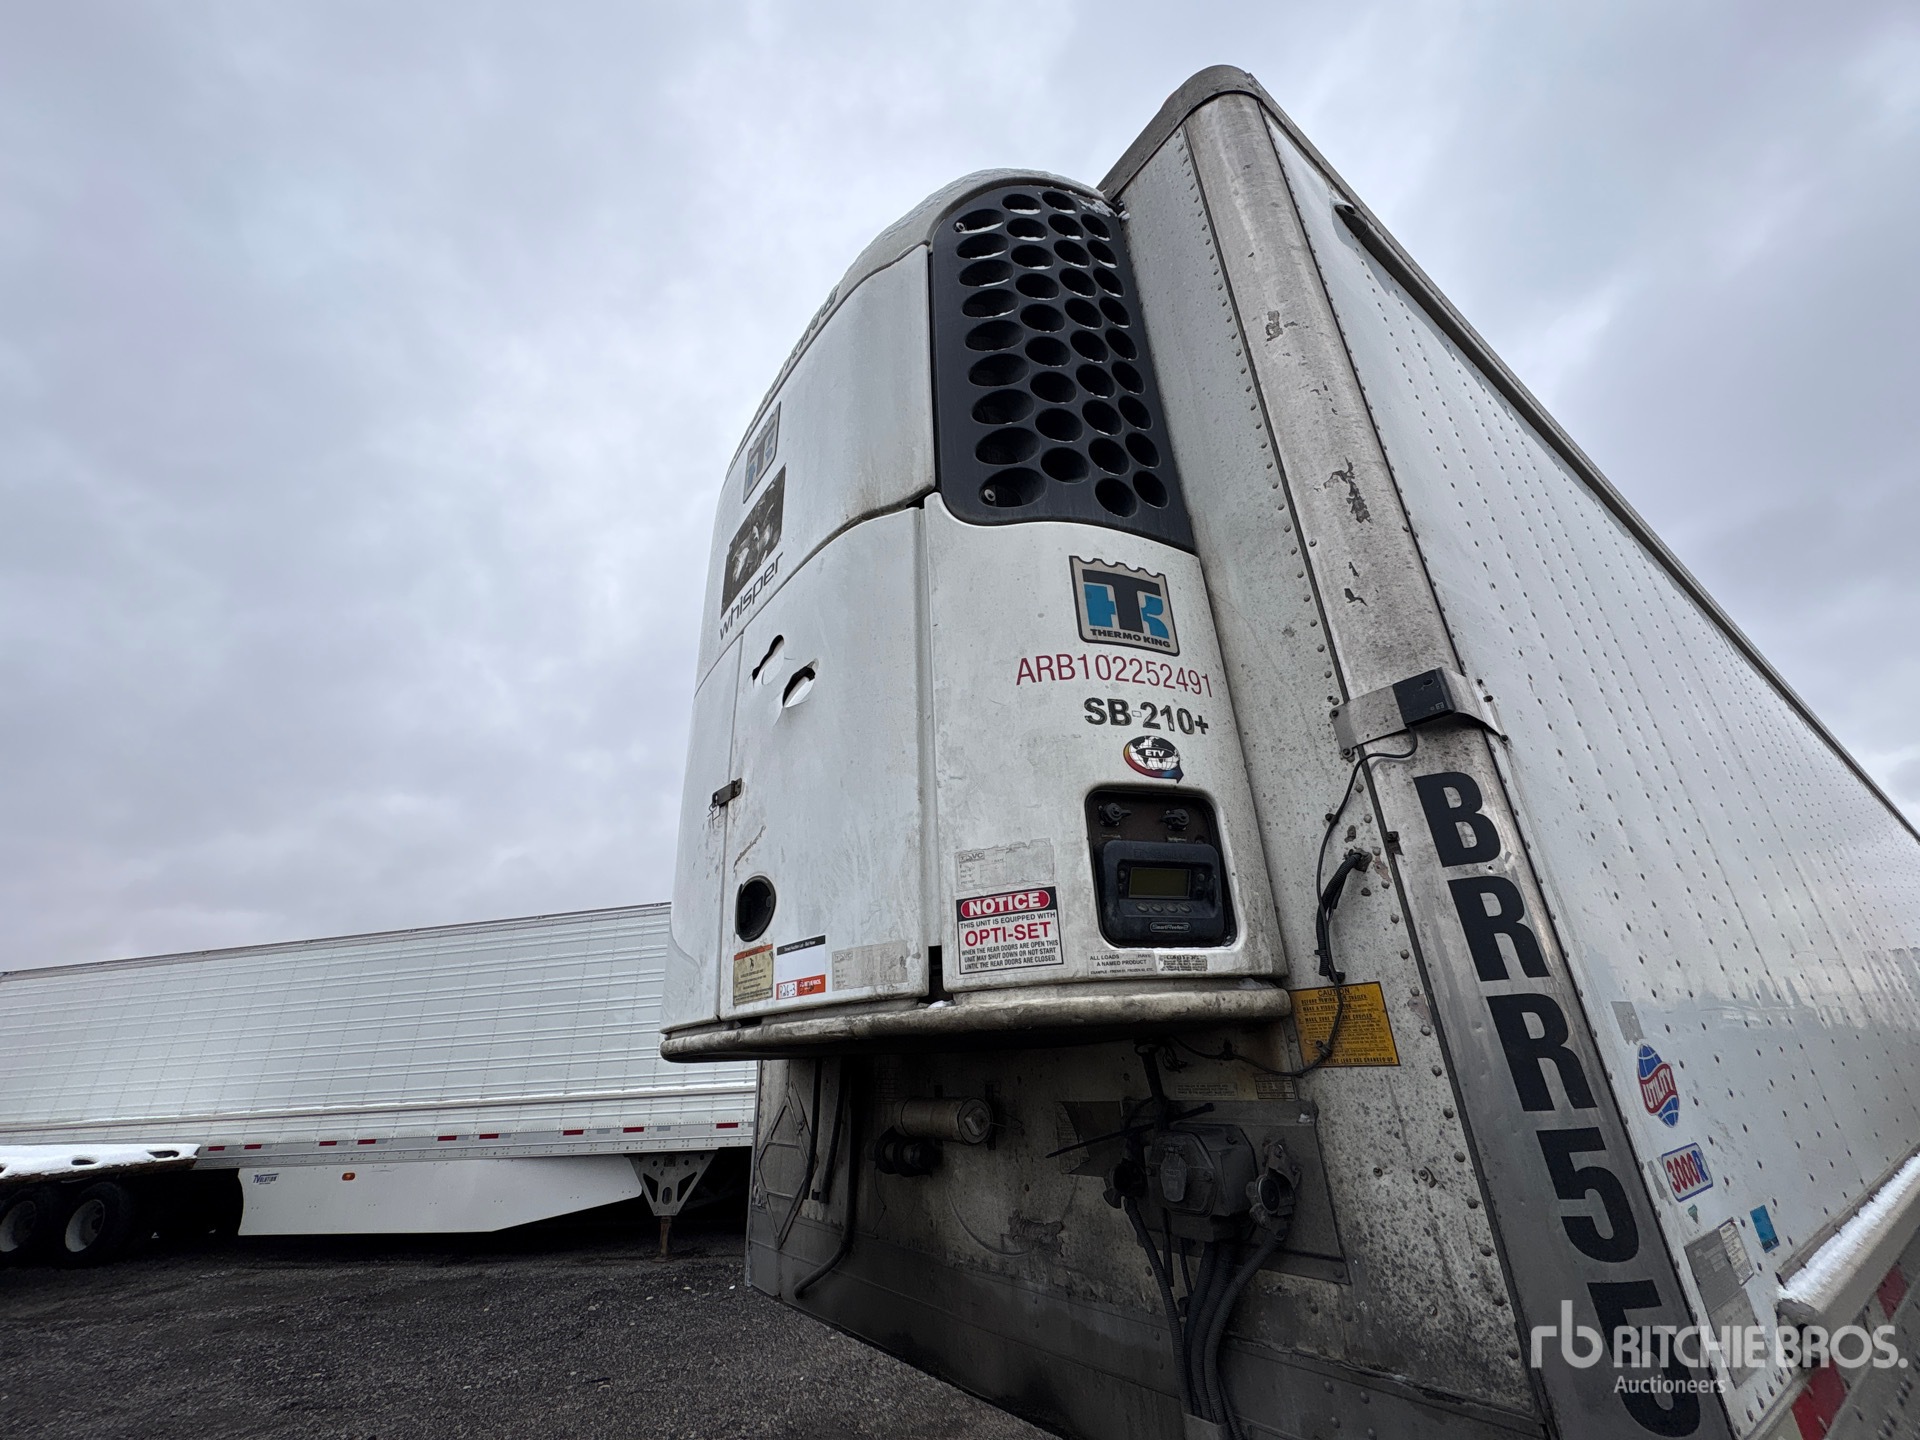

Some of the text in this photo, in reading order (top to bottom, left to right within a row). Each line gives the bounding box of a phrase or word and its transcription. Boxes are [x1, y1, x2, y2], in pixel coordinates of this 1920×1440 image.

[719, 552, 784, 641] whisper
[1090, 628, 1171, 649] THERMO KING
[1015, 653, 1213, 698] ARB102252491
[1144, 748, 1166, 758] ETV
[969, 892, 1041, 916] NOTICE
[960, 921, 975, 929] THIS
[976, 920, 991, 928] UNIT
[1000, 913, 1036, 924] EQUIPPED
[1037, 911, 1056, 920] WITH
[965, 921, 1052, 947] OPTI-SET
[961, 948, 976, 956] WHEN
[977, 947, 986, 955] THE
[1001, 943, 1018, 952] DOORS
[1019, 942, 1030, 950] ARE
[1031, 940, 1045, 948] OPEN
[1046, 939, 1059, 947] THIS
[964, 955, 976, 963] UNIT
[988, 952, 1001, 960] SHUT
[1002, 951, 1018, 959] DOWN
[1027, 948, 1038, 956] NOT
[964, 963, 979, 971] UNTIL
[980, 961, 989, 969] THE
[1004, 958, 1022, 966] DOORS
[1023, 956, 1034, 964] ARE
[1317, 987, 1350, 997] CAUTON
[1643, 1067, 1675, 1110] UTILITY
[1666, 1149, 1709, 1194] 3000R
